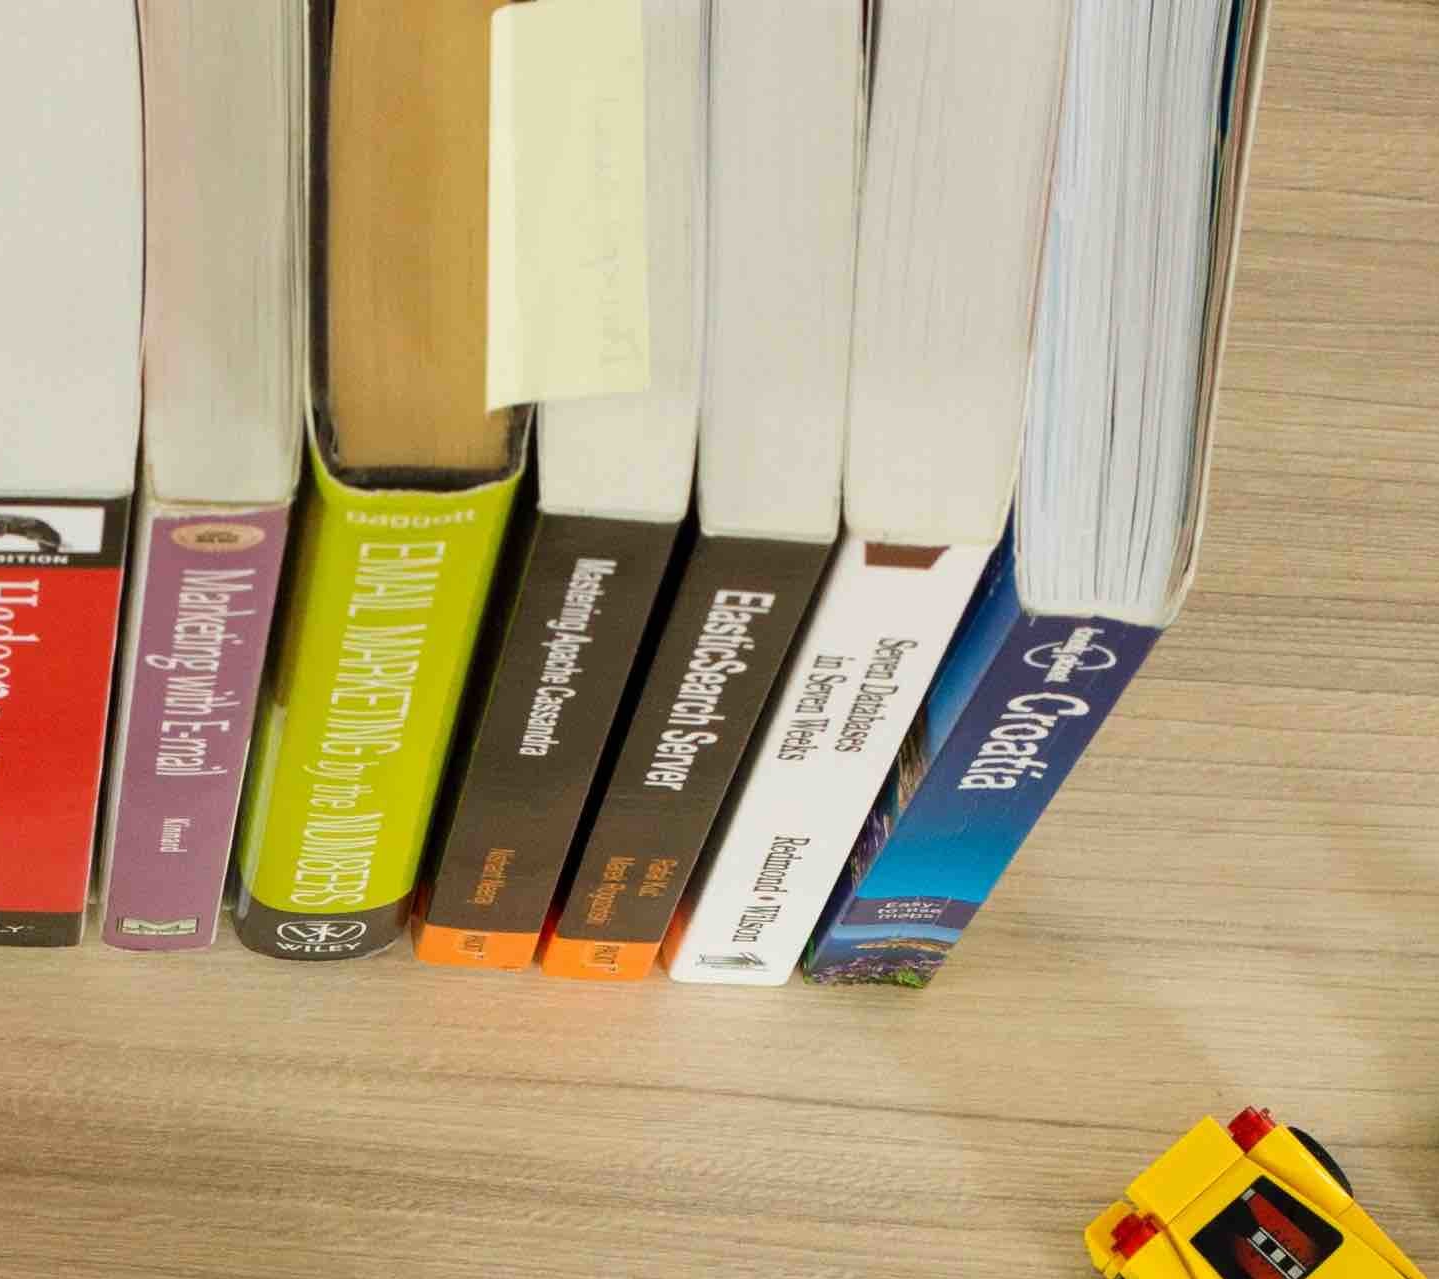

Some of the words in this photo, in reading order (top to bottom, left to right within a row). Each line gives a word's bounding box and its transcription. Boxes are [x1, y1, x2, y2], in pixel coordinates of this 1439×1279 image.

[346, 540, 446, 618] EMAIL
[545, 558, 617, 631] Mastering
[143, 568, 255, 672] Marketing
[539, 631, 592, 684] Apache
[666, 589, 775, 726] ElasticSearch
[811, 654, 855, 670] in
[862, 637, 918, 680] Seven
[162, 674, 238, 716] with
[317, 623, 427, 756] MARKETING
[794, 673, 847, 714] Seven
[833, 682, 899, 753] Databases
[154, 719, 230, 776] E-mail
[517, 685, 576, 756] Cassandra
[775, 717, 830, 761] Weeks
[958, 693, 1089, 791] Croatia
[301, 756, 365, 782] by
[642, 729, 718, 791] Server
[306, 783, 374, 812] the
[158, 817, 190, 853] Kinnard
[287, 811, 384, 906] NUMBERS
[751, 835, 811, 893] Redmond
[275, 941, 363, 953] WILEY
[730, 904, 781, 943] Wilson
